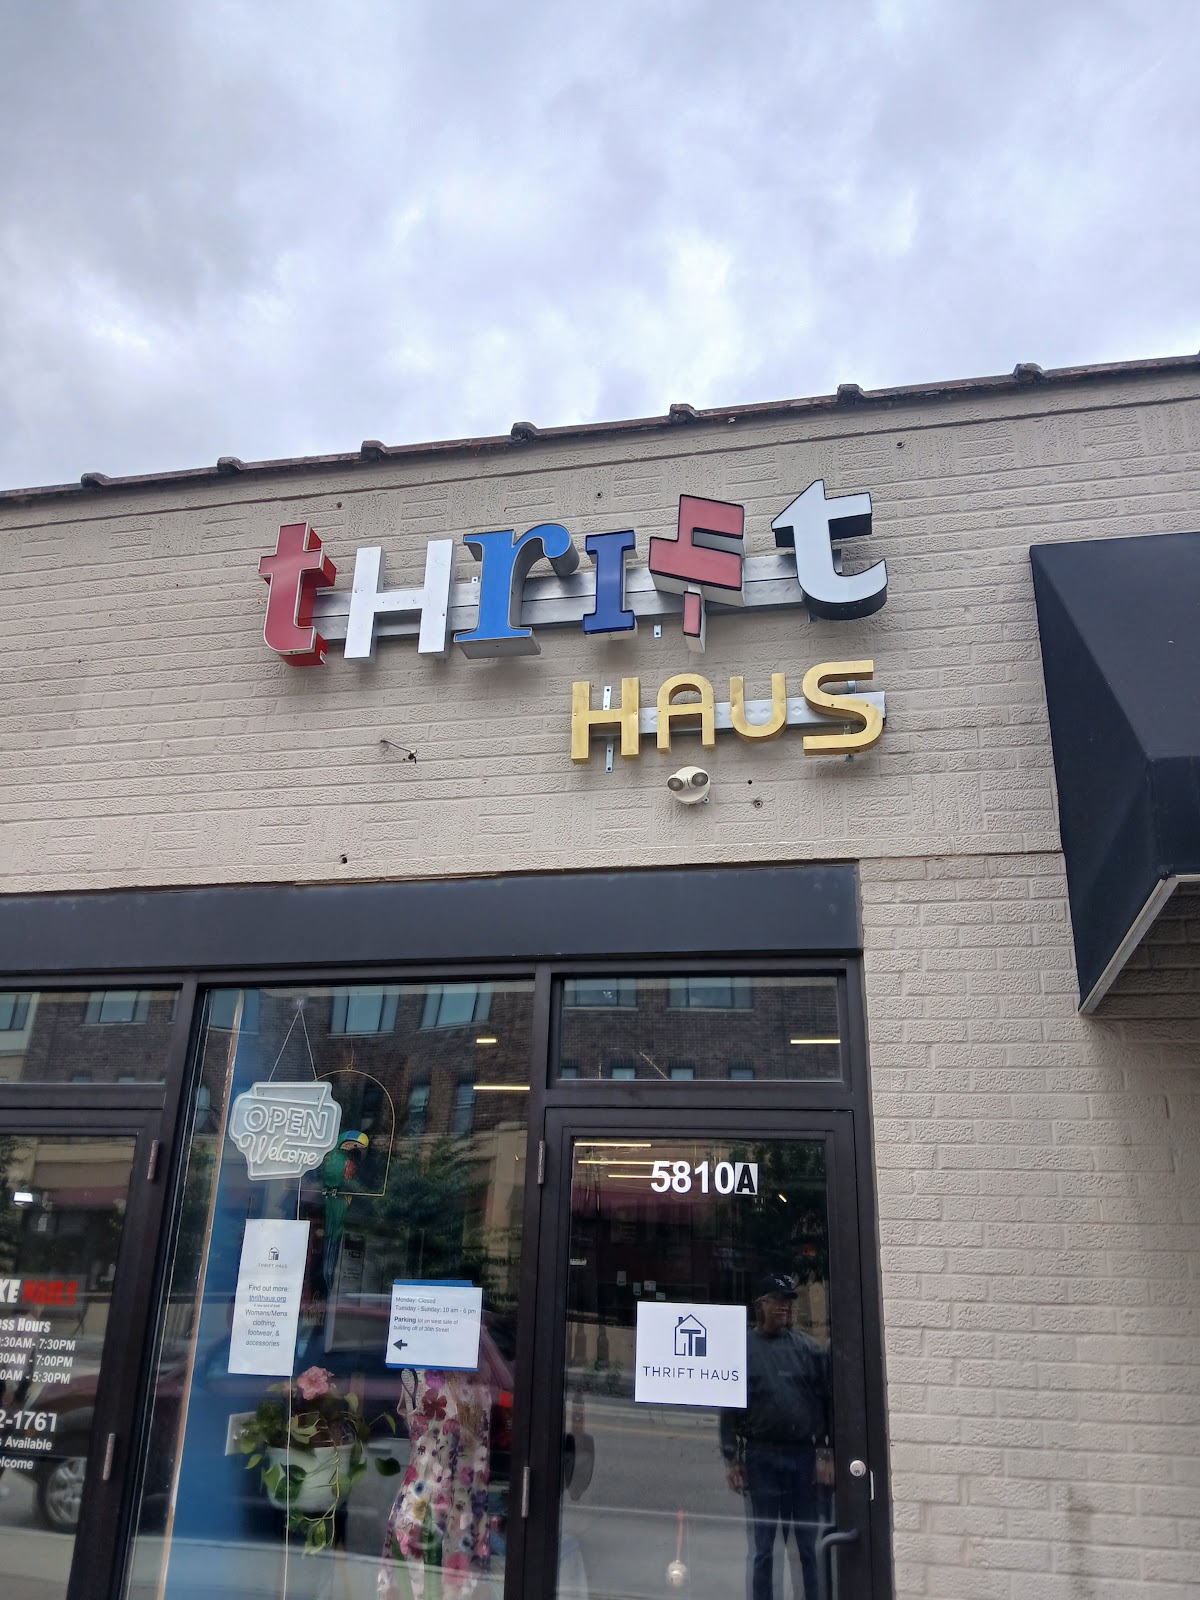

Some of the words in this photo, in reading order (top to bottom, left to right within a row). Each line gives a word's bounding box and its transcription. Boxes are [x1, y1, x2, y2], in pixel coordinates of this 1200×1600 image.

[570, 660, 886, 764] HAUS
[244, 1104, 328, 1139] OPEN
[239, 1132, 319, 1165] Welcome
[249, 1294, 287, 1303] thrifthaus.org
[395, 1296, 416, 1304] Monday:
[420, 1306, 441, 1314] Sunday:
[17, 1317, 51, 1333] Hours
[394, 1316, 417, 1324] Parking
[39, 1338, 76, 1351] 7:30PM
[36, 1355, 73, 1368] 7:00PM
[32, 1371, 71, 1385] 5:30PM
[643, 1365, 695, 1380] THRIFT
[700, 1367, 739, 1382] HAUS
[4, 1436, 53, 1451] Available
